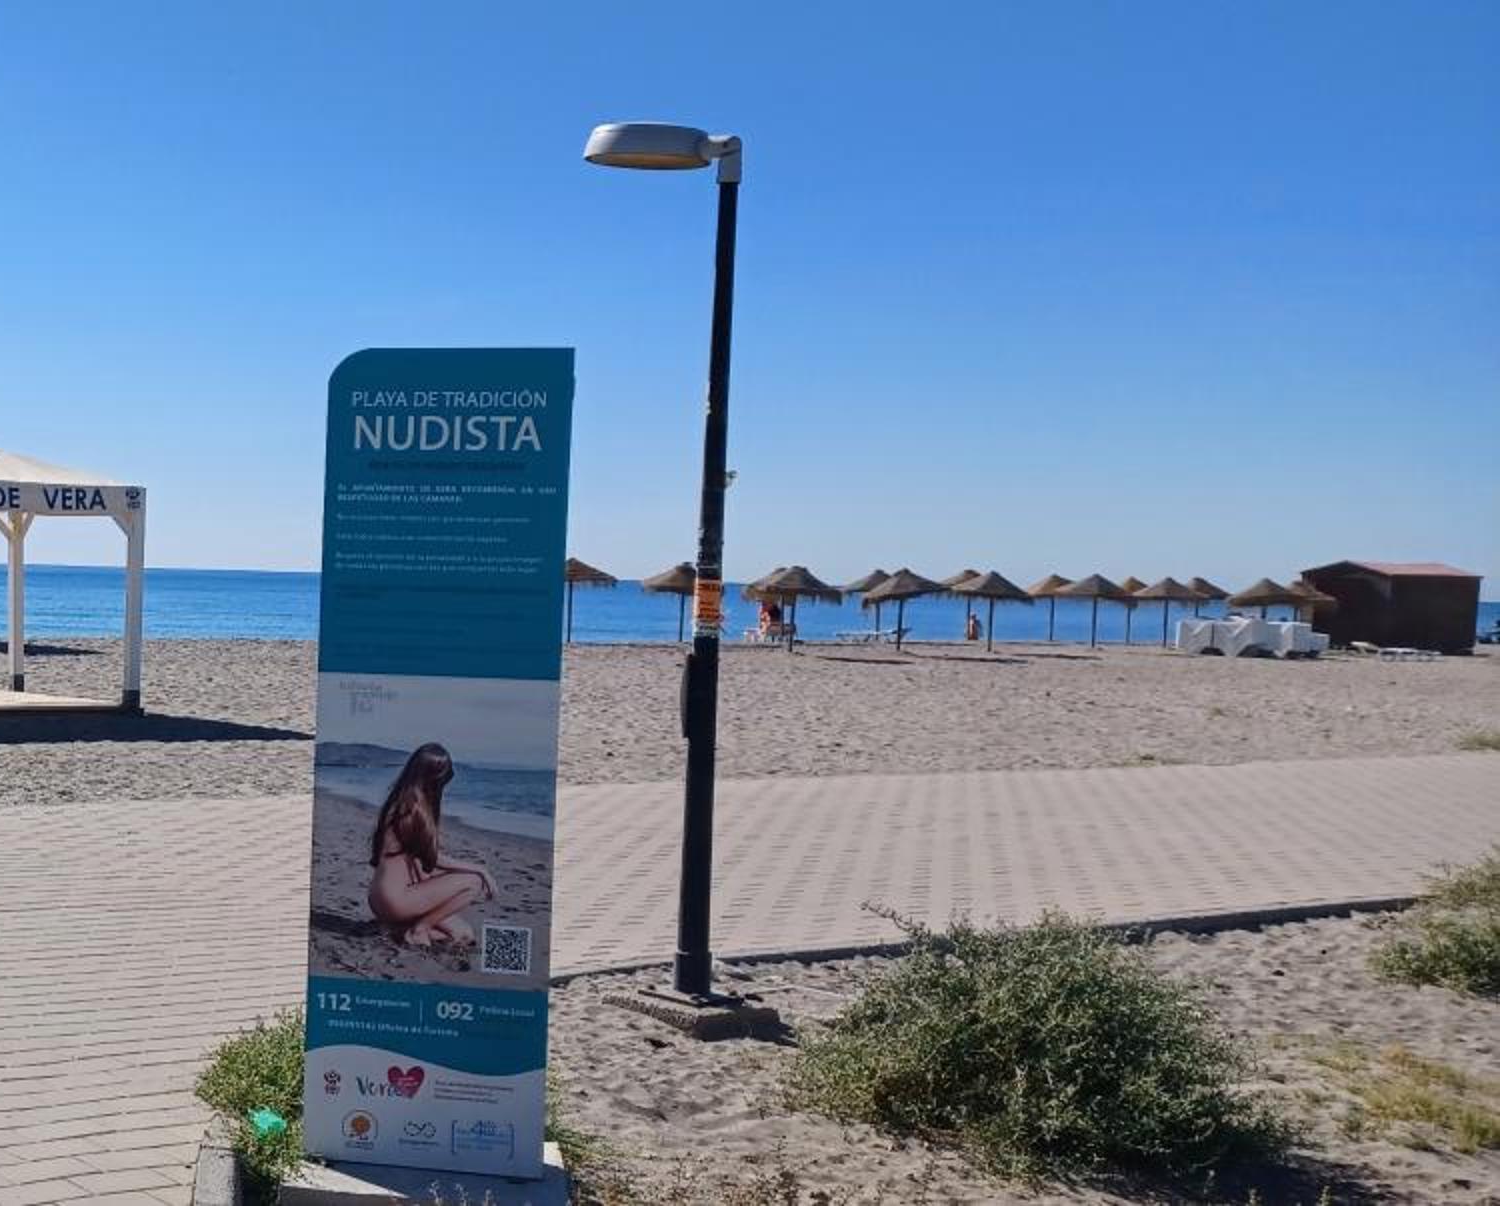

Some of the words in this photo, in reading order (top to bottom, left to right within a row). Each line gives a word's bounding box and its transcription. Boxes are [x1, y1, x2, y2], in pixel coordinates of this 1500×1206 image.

[352, 391, 408, 407] PLAYA
[413, 391, 438, 407] DE
[440, 389, 547, 408] TRADICIÓN
[353, 415, 542, 451] NUDISTA
[43, 487, 107, 511] VERA
[316, 992, 351, 1012] 112
[436, 1000, 475, 1021] 092
